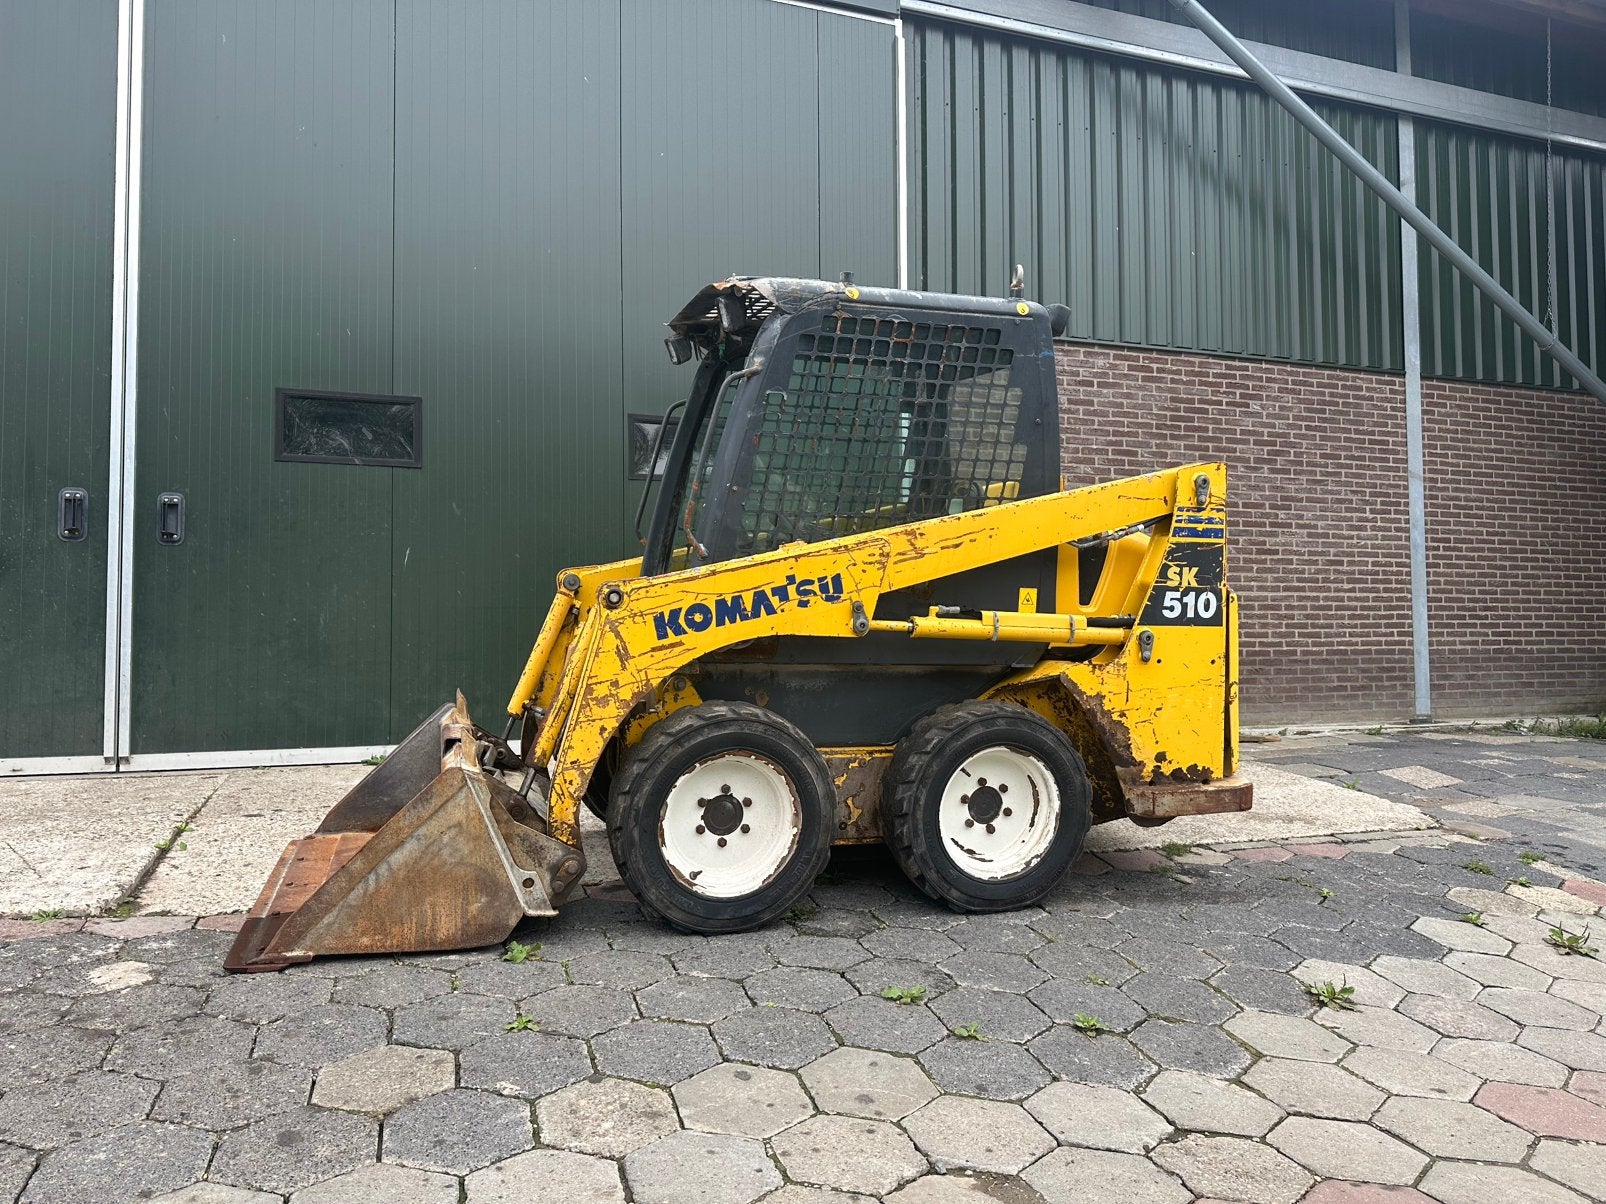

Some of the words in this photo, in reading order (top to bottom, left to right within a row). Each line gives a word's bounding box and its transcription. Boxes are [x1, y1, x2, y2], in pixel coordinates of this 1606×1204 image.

[1167, 566, 1199, 587] SK
[653, 572, 844, 641] KOMATSU
[1161, 591, 1217, 619] 510
